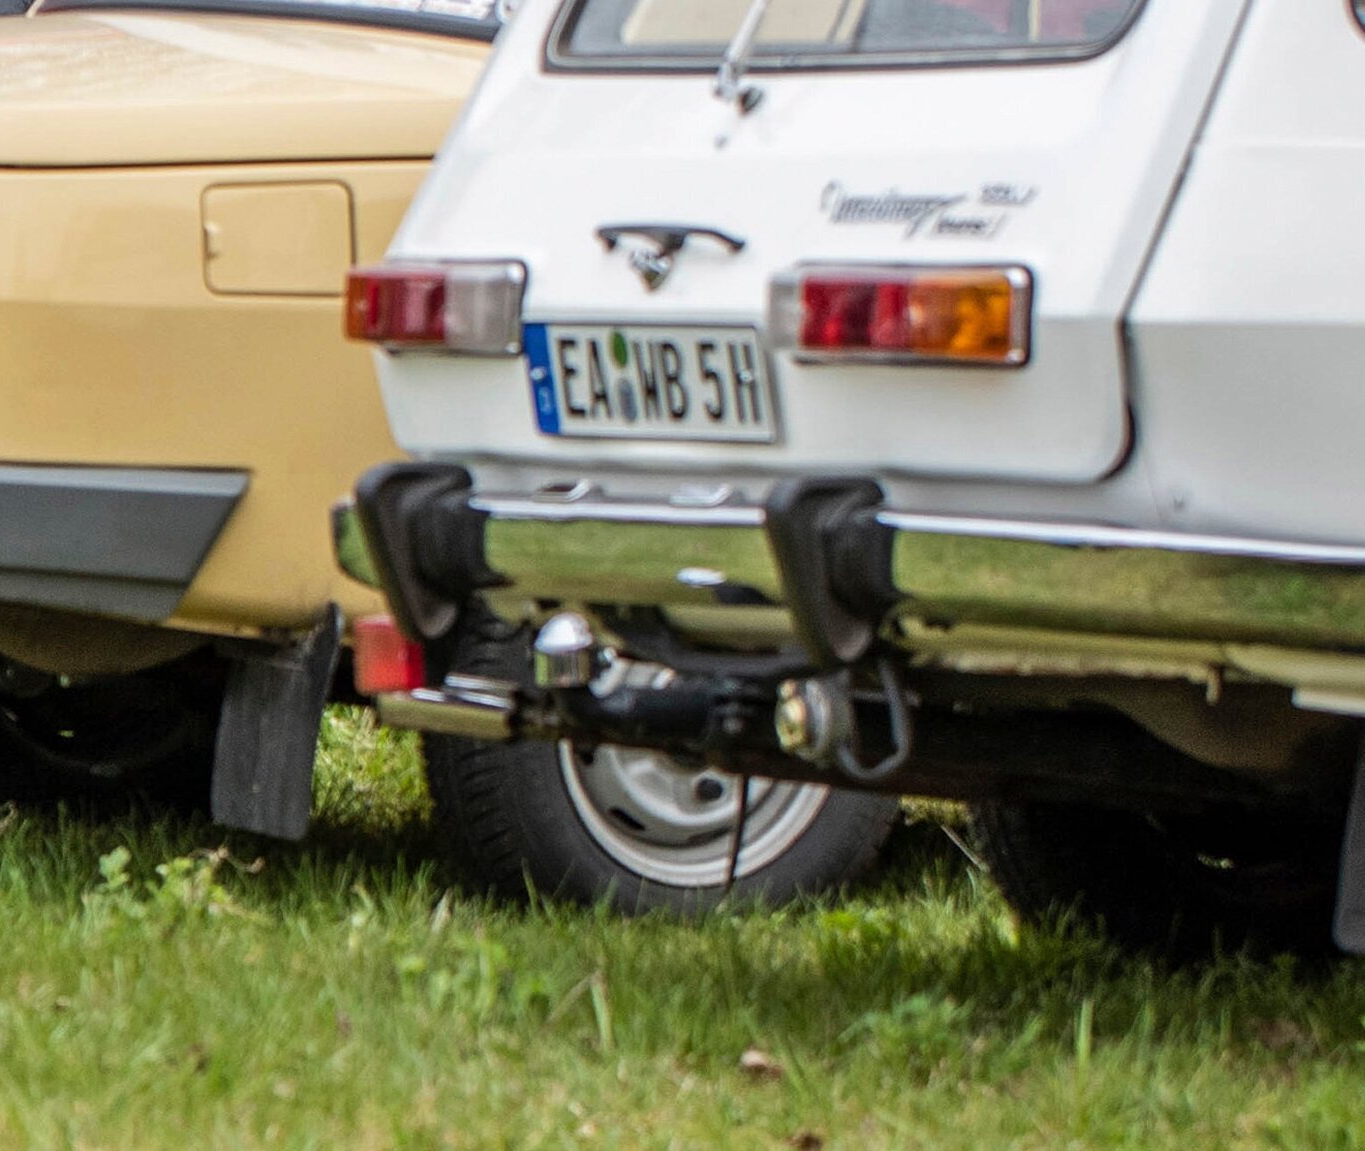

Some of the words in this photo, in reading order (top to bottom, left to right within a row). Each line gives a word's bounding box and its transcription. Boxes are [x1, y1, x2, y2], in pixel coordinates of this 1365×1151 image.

[558, 338, 612, 419] EA
[632, 339, 688, 420] WB
[696, 341, 762, 423] 5H
